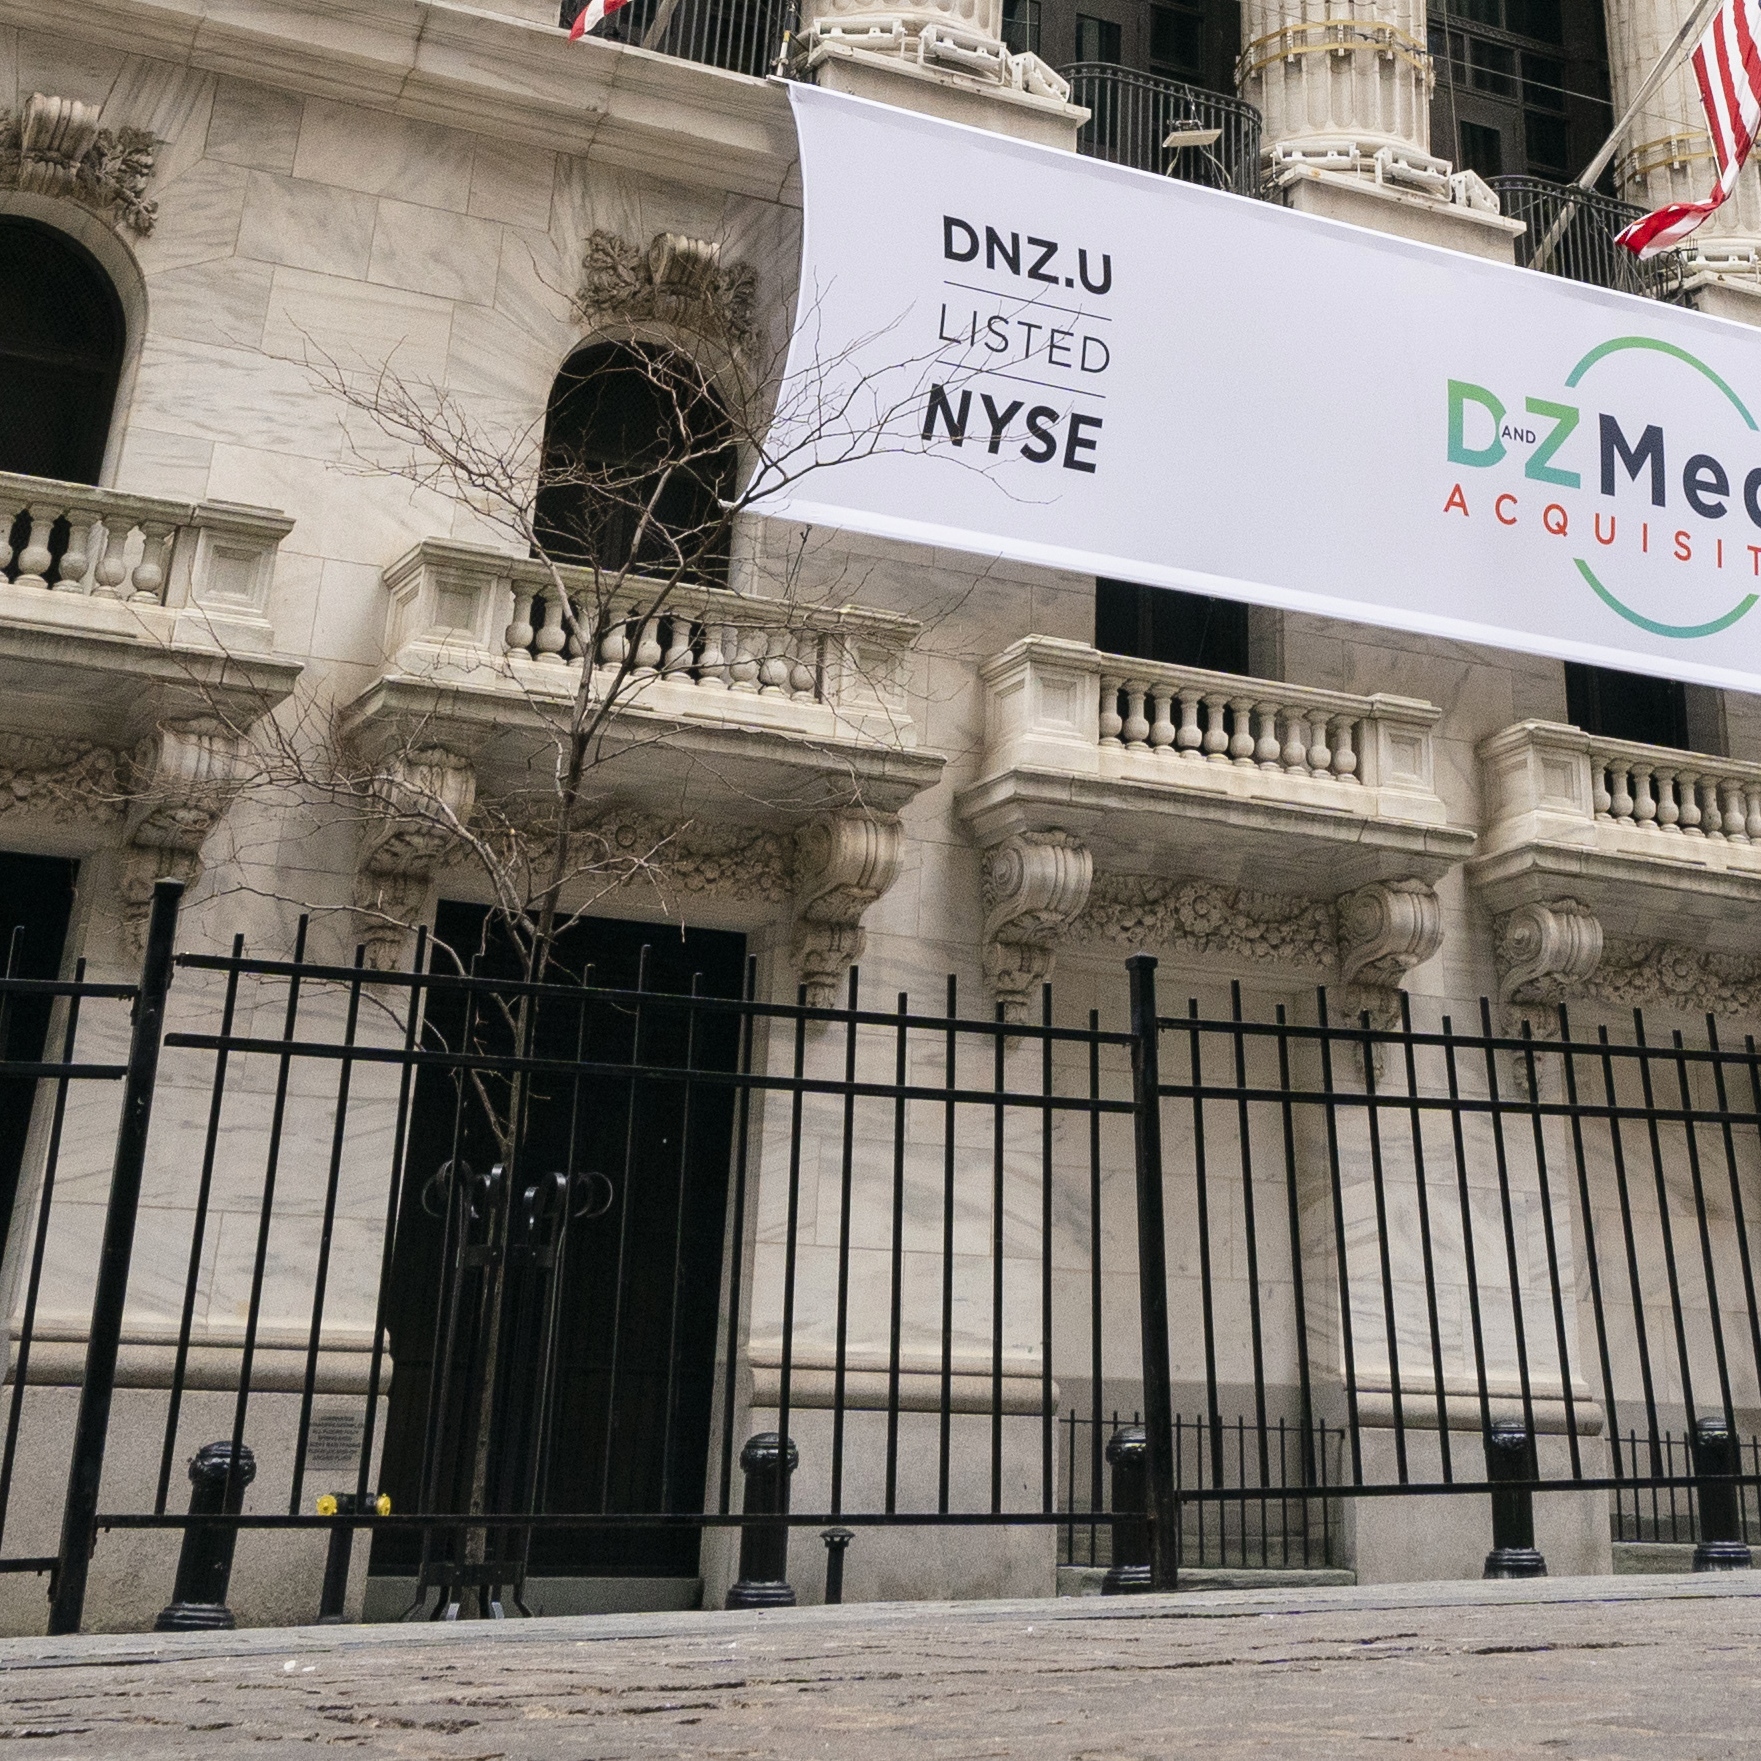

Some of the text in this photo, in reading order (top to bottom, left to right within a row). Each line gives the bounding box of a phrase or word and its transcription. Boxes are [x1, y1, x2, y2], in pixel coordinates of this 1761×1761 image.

[943, 214, 1112, 295] DNZ.U
[939, 303, 1111, 374] LISTED
[921, 382, 1104, 474] NYSE
